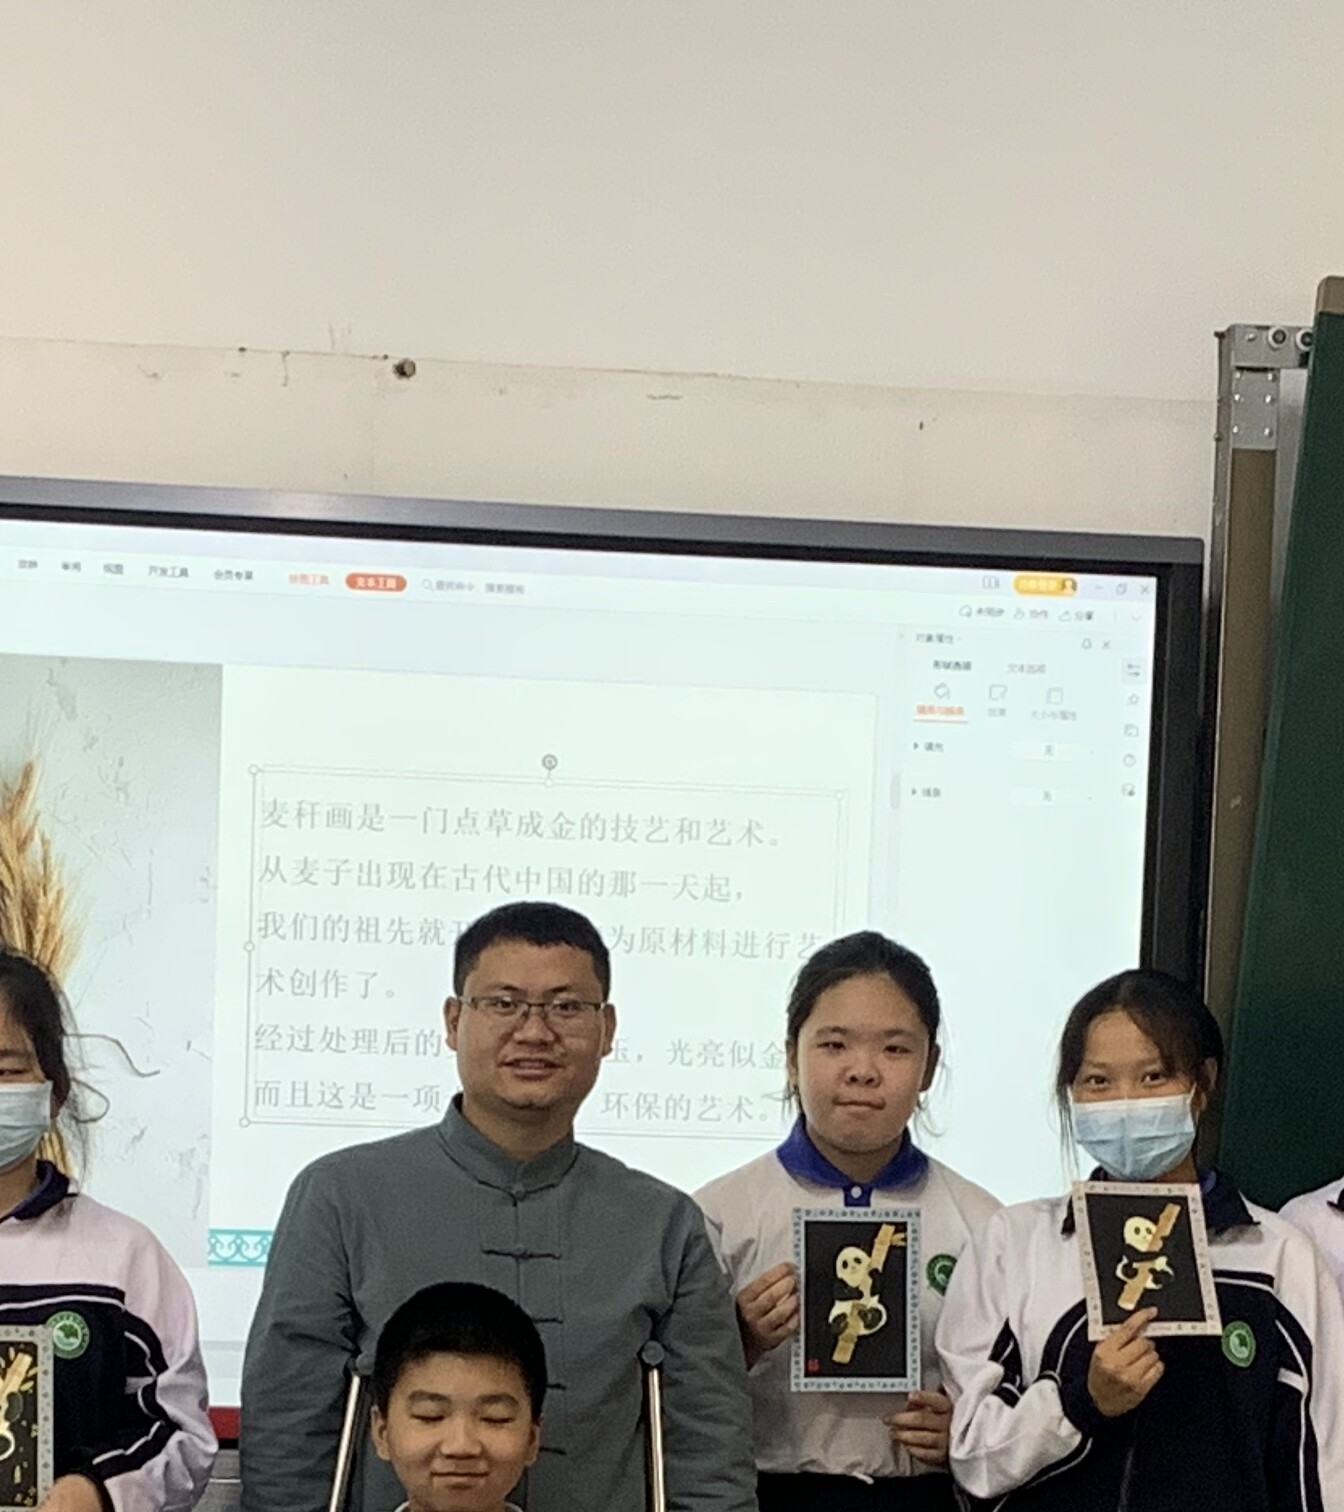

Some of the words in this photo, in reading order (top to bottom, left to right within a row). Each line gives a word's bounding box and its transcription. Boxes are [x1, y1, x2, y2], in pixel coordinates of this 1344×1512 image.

[260, 796, 779, 849] 麦秆画是一门点草成金的技艺和艺术。
[255, 966, 397, 1001] 术创作了。
